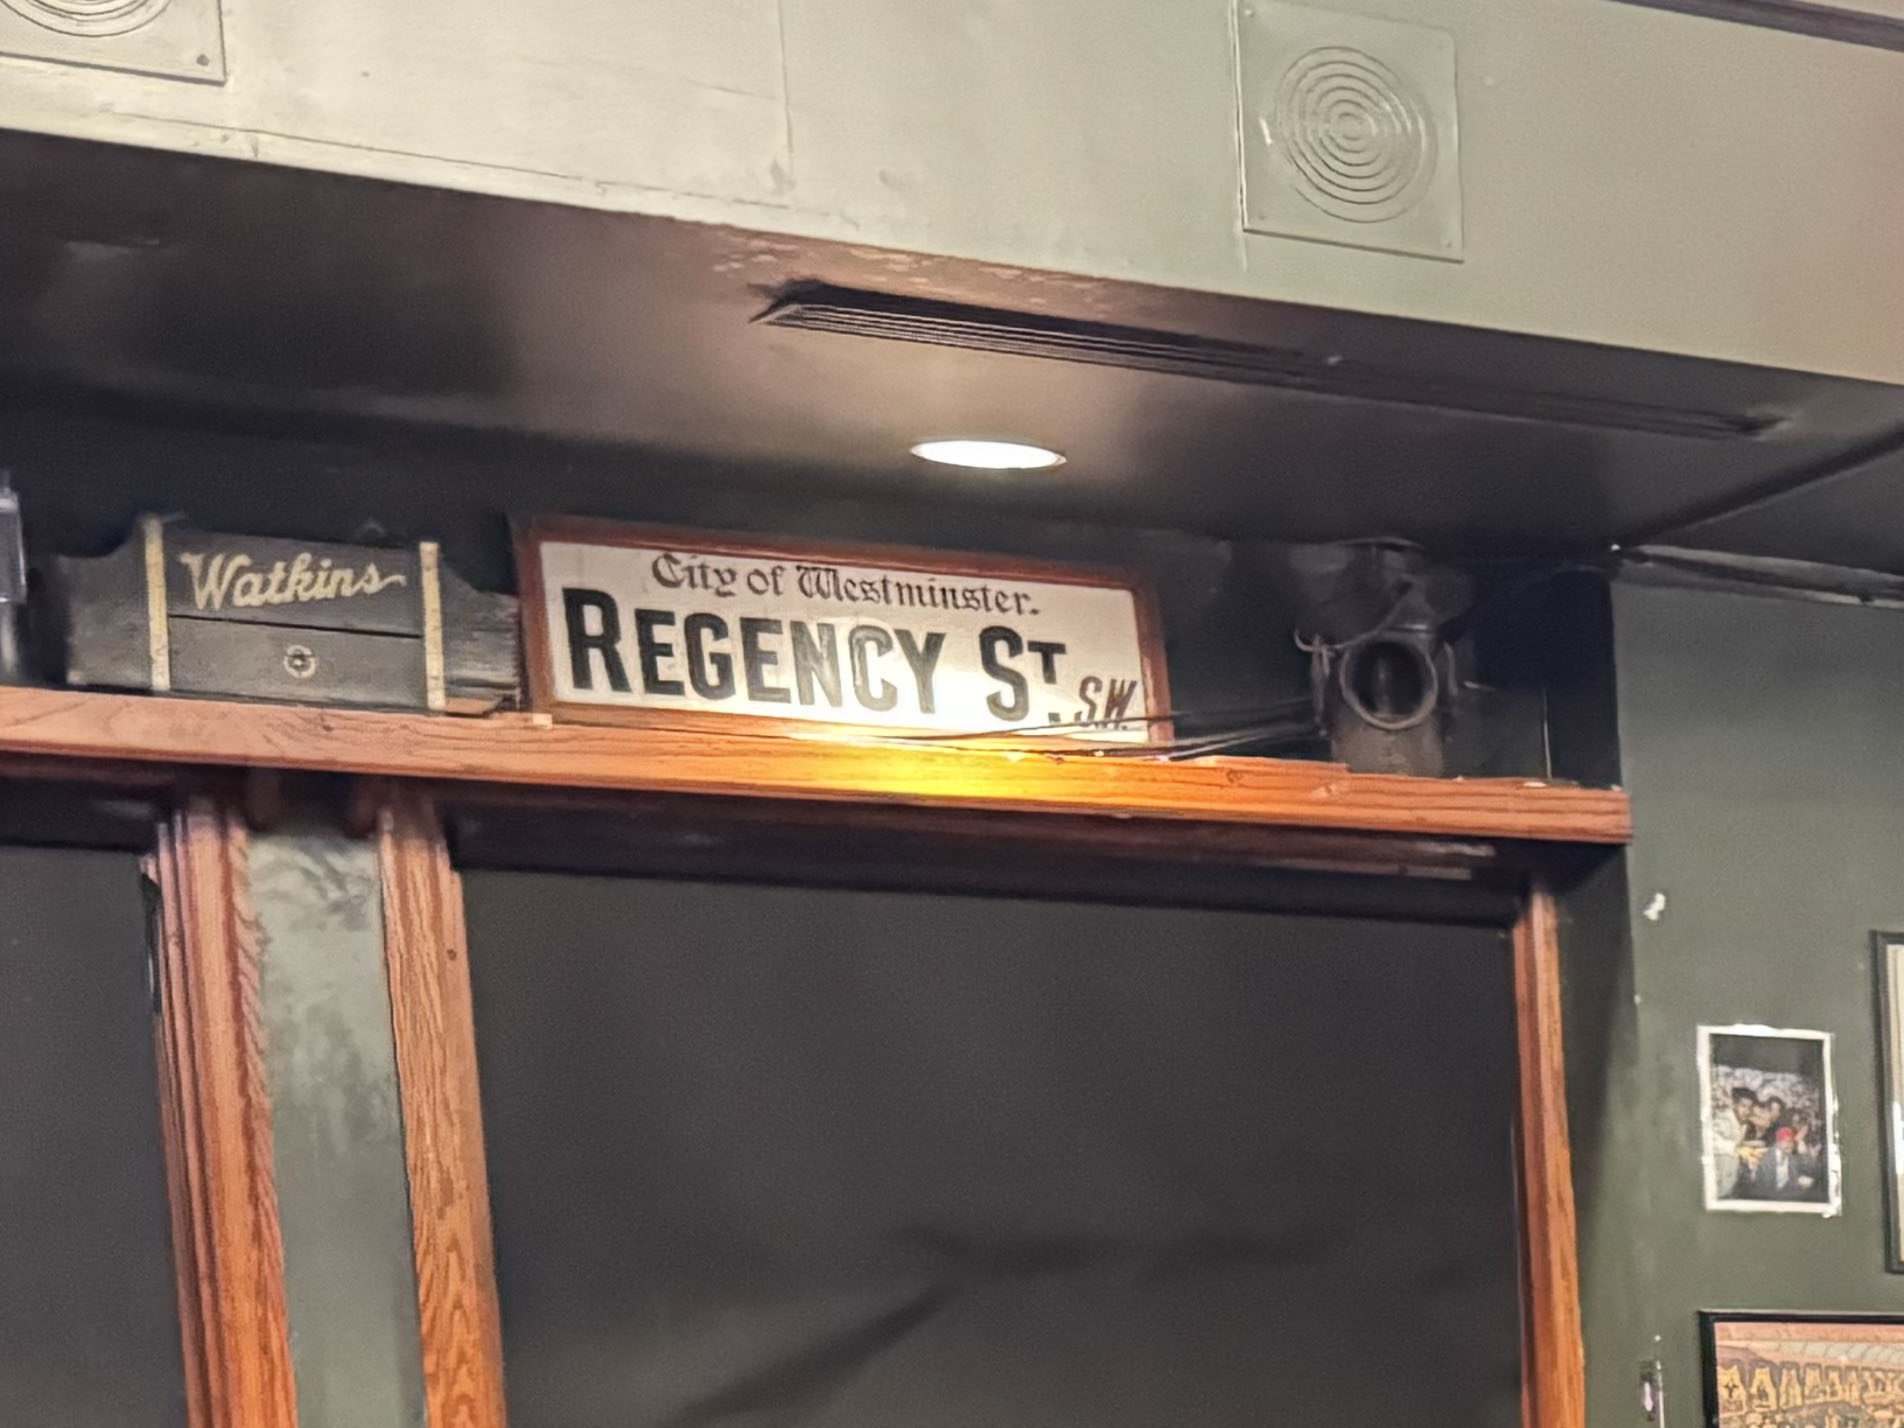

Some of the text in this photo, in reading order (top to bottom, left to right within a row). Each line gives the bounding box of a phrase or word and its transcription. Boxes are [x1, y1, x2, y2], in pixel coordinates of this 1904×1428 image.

[179, 552, 407, 610] Watkins
[652, 553, 737, 597] City
[747, 565, 785, 596] of
[562, 587, 947, 715] REGENCY
